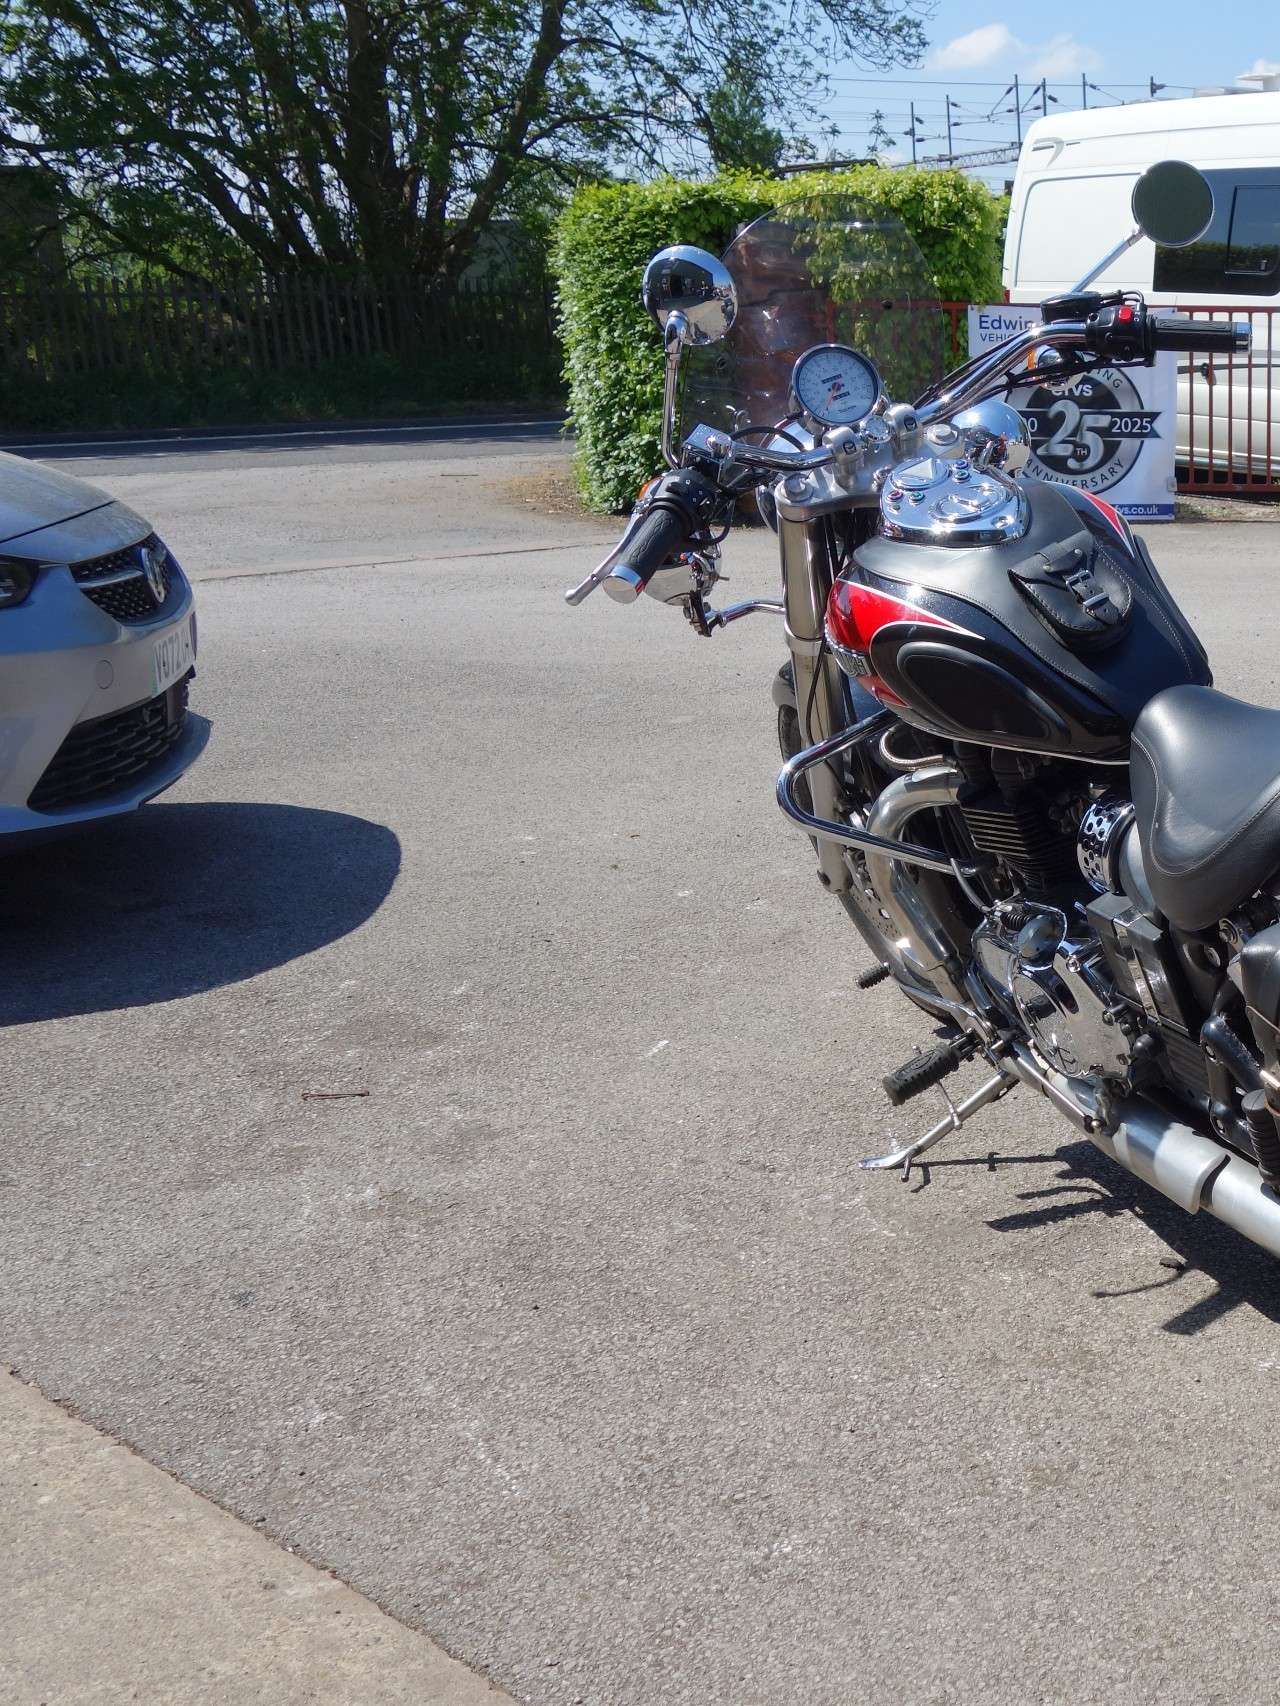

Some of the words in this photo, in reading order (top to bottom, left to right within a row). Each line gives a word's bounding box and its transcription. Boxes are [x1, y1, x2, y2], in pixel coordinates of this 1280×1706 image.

[1111, 417, 1151, 433] 2025
[1036, 399, 1112, 471] 25
[1076, 447, 1088, 456] TH
